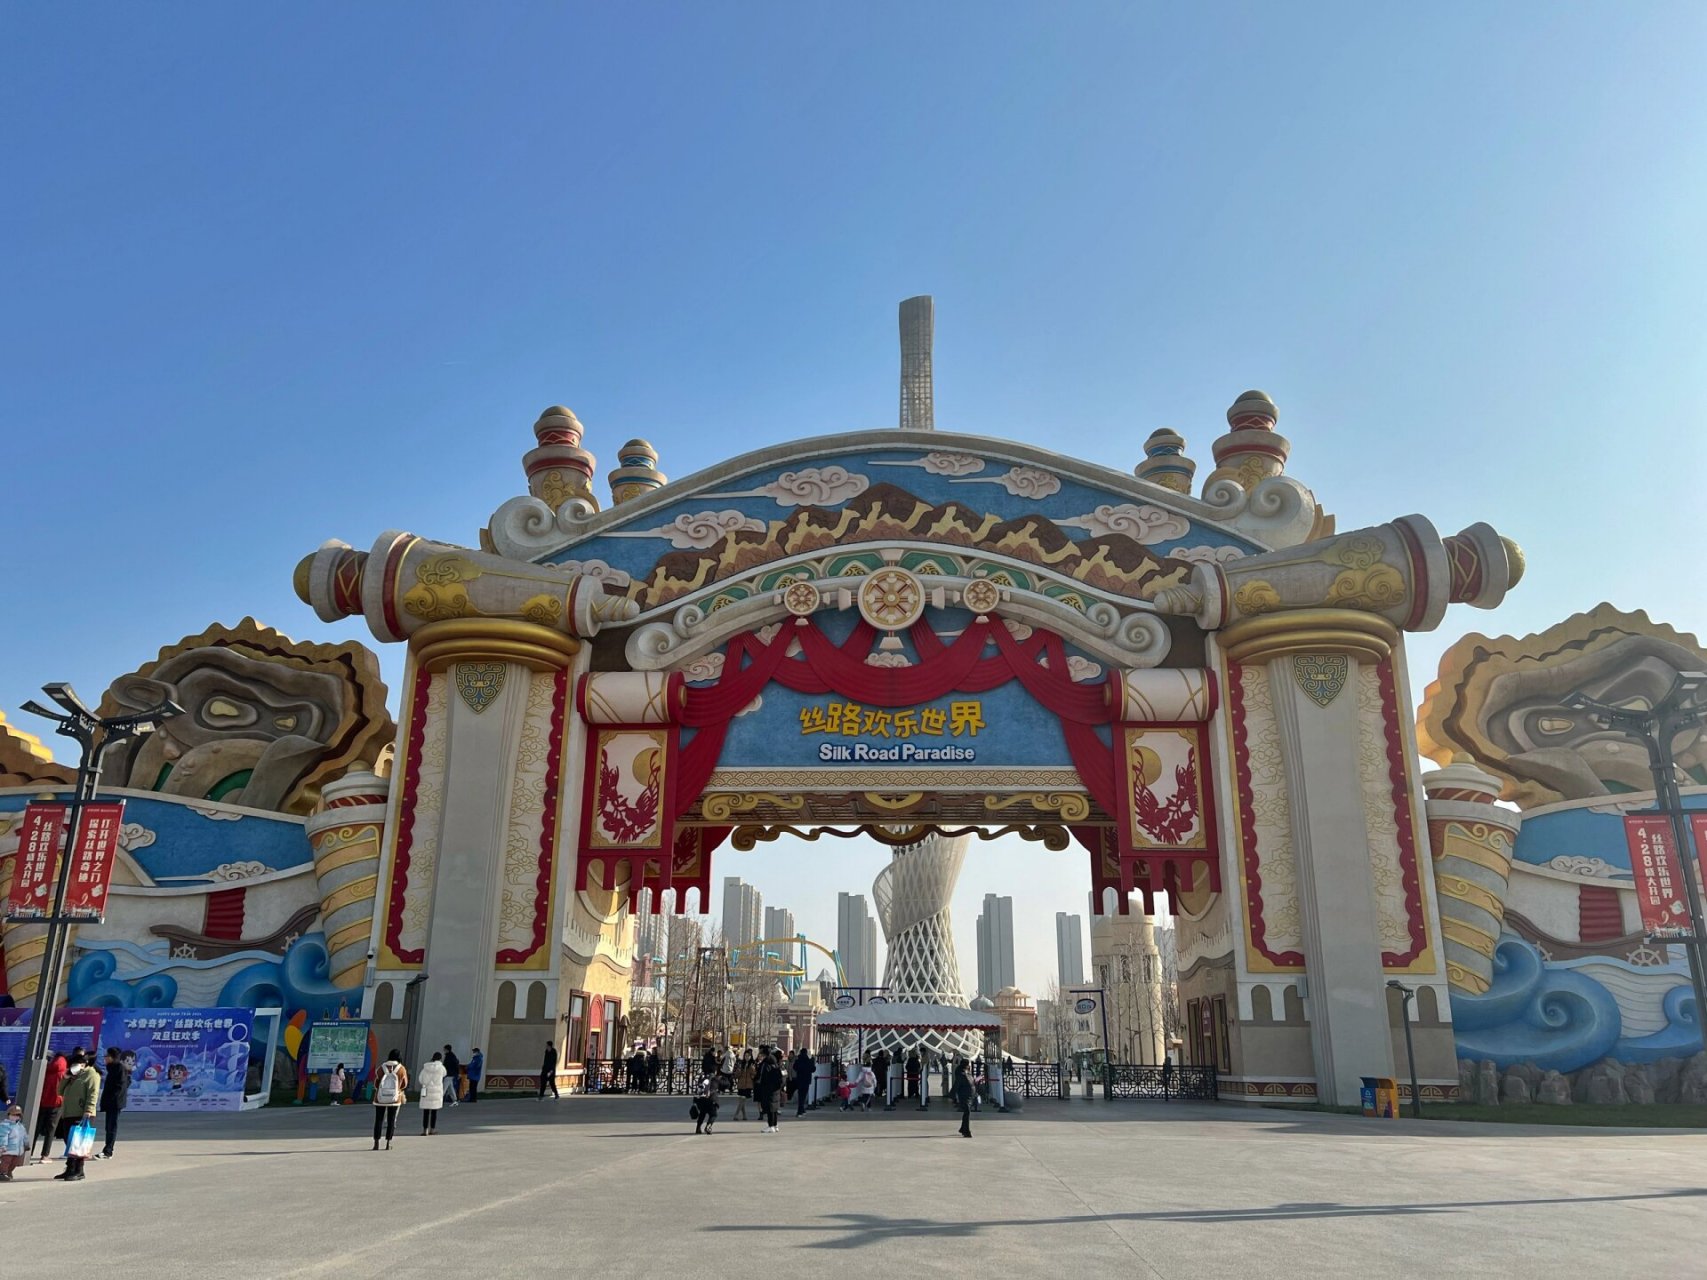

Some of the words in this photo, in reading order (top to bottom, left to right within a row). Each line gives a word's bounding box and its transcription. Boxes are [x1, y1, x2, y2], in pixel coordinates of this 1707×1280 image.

[799, 701, 986, 738] 丝路欢乐世界
[819, 743, 851, 761] Silk
[854, 743, 899, 761] Road
[901, 743, 975, 761] Paradise
[33, 821, 52, 882] 丝路欢乐世界
[90, 818, 111, 883] 打开世界之门
[1651, 833, 1673, 899] 丝路欢乐世界
[151, 1031, 201, 1041] 双旦狂欢季
[174, 1018, 233, 1029] 丝路欢乐世界
